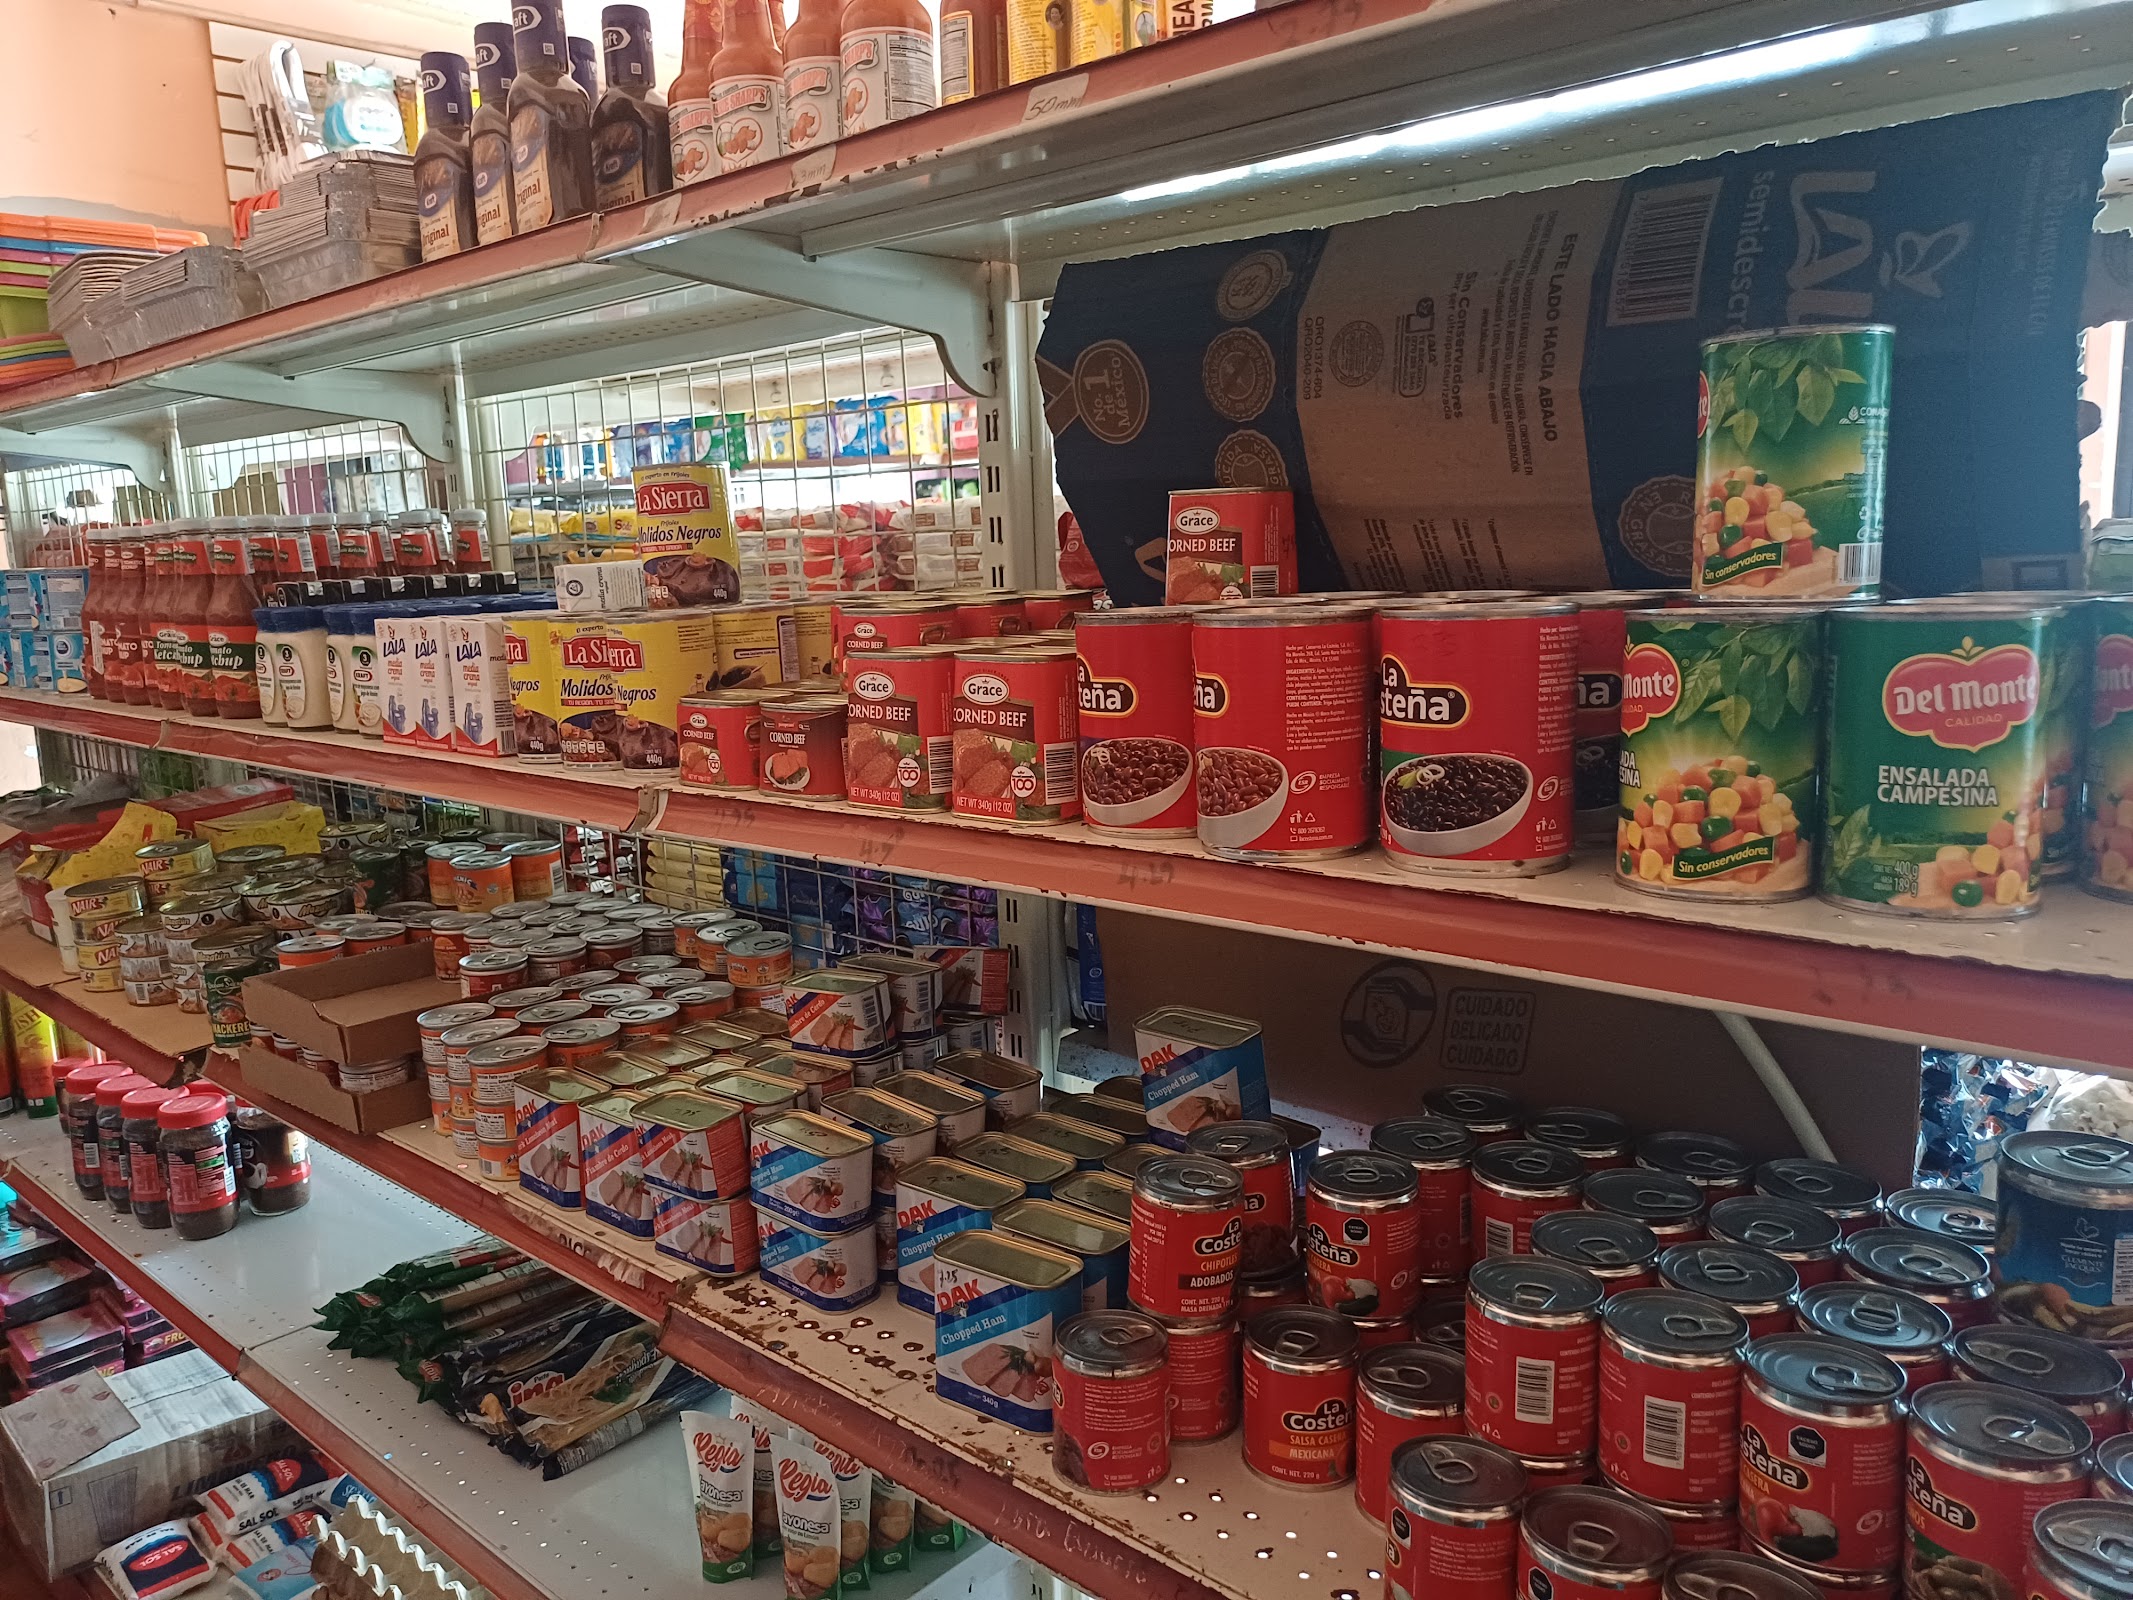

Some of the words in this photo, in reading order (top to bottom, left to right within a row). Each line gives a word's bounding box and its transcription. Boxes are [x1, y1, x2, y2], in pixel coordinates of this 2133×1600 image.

[1553, 233, 1579, 272] ESTE
[1545, 274, 1565, 322] LADO
[1451, 296, 1470, 419] Conservadores
[1538, 327, 1559, 382] HACIA
[1111, 356, 1131, 428] Mexico
[1538, 385, 1559, 442] ABAJO
[637, 492, 651, 513] La
[651, 484, 705, 511] Sierra
[1180, 514, 1214, 528] Grace
[676, 525, 722, 545] Negros
[1168, 538, 1206, 553] ORNED
[1209, 537, 1237, 552] BEEF
[1705, 570, 1714, 580] Sin
[1715, 553, 1777, 578] conservadores
[713, 588, 727, 599] 440g
[383, 638, 406, 658] LALA
[415, 639, 438, 659] LALA
[456, 641, 482, 662] LALA
[567, 644, 589, 664] La
[870, 640, 884, 649] BEEF
[388, 659, 403, 668] media
[388, 668, 403, 676] crema
[420, 662, 435, 671] media
[463, 664, 479, 673] media
[420, 671, 436, 679] crema
[463, 673, 481, 682] crema
[1382, 662, 1398, 687] La
[561, 679, 614, 697] Molidos
[616, 685, 657, 706] Negros
[858, 680, 889, 693] Grace
[968, 683, 1003, 697] Grace
[1893, 684, 1945, 716] Del
[1950, 674, 2036, 711] Monte
[691, 717, 705, 725] Grace
[885, 706, 912, 722] BEEF
[953, 707, 996, 725] CORNED
[999, 710, 1028, 728] BEEF
[1945, 713, 2003, 728] CALIDAD
[683, 730, 703, 739] CORNED
[703, 731, 715, 740] BEEF
[769, 732, 793, 743] CORNED
[793, 733, 806, 745] BEEF
[529, 741, 544, 752] 440g
[647, 754, 663, 766] 440g
[1877, 765, 1989, 787] ENSALADA
[850, 787, 860, 797] NET
[860, 788, 868, 798] WT
[868, 788, 882, 801] 340g
[882, 791, 890, 802] (12
[890, 791, 900, 802] OZ)
[1876, 785, 1999, 807] CAMPESINA
[956, 796, 967, 807] NET
[968, 797, 977, 808] WT
[977, 799, 992, 812] 340g
[993, 801, 1002, 812] (12
[1002, 802, 1013, 814] OZ)
[140, 860, 164, 875] NAIR
[1678, 860, 1694, 874] Sin
[1696, 846, 1769, 872] conservadores
[1894, 860, 1911, 876] 400
[1894, 877, 1910, 892] 189
[72, 899, 97, 914] NAIR
[803, 1009, 811, 1018] de
[810, 999, 826, 1012] Cerdo
[1455, 995, 1528, 1017] CUIDADO
[1450, 1020, 1523, 1041] DELICADO
[1140, 1044, 1180, 1074] DAK
[1448, 1046, 1518, 1066] CUIDADO
[1148, 1080, 1179, 1101] Chopped
[1179, 1071, 1199, 1087] Ham
[516, 1099, 538, 1125] DAK
[581, 1123, 607, 1149] DAK
[636, 1124, 647, 1136] AK
[607, 1155, 614, 1163] de
[613, 1144, 629, 1159] Cerdo
[751, 1140, 773, 1160] AK
[652, 1194, 666, 1206] AK
[897, 1199, 938, 1228] DAK
[758, 1221, 778, 1235] AK
[1229, 1220, 1240, 1233] La
[1312, 1225, 1324, 1240] La
[902, 1235, 937, 1258] Chopped
[936, 1230, 956, 1244] Ham
[1201, 1231, 1242, 1253] Coste
[1190, 1270, 1234, 1288] ADOBADOS
[936, 1279, 984, 1312] DAK
[1181, 1305, 1198, 1313] MASA
[941, 1320, 982, 1345] Chopped
[982, 1313, 1007, 1330] Ham
[982, 1395, 999, 1408] 340g
[1323, 1404, 1339, 1416] La
[1290, 1434, 1316, 1446] SALSA
[1747, 1427, 1761, 1446] La
[693, 1431, 744, 1473] Regia
[1289, 1448, 1335, 1460] MEXICANA
[778, 1457, 833, 1502] Regia
[1271, 1465, 1287, 1474] CONT.
[1288, 1469, 1301, 1478] NET.
[1911, 1460, 1925, 1481] La
[700, 1480, 743, 1501] ayonesa
[238, 1513, 257, 1532] SAL
[259, 1506, 280, 1522] SOL
[782, 1511, 831, 1534] ayonesa
[162, 1544, 184, 1556] SAL
